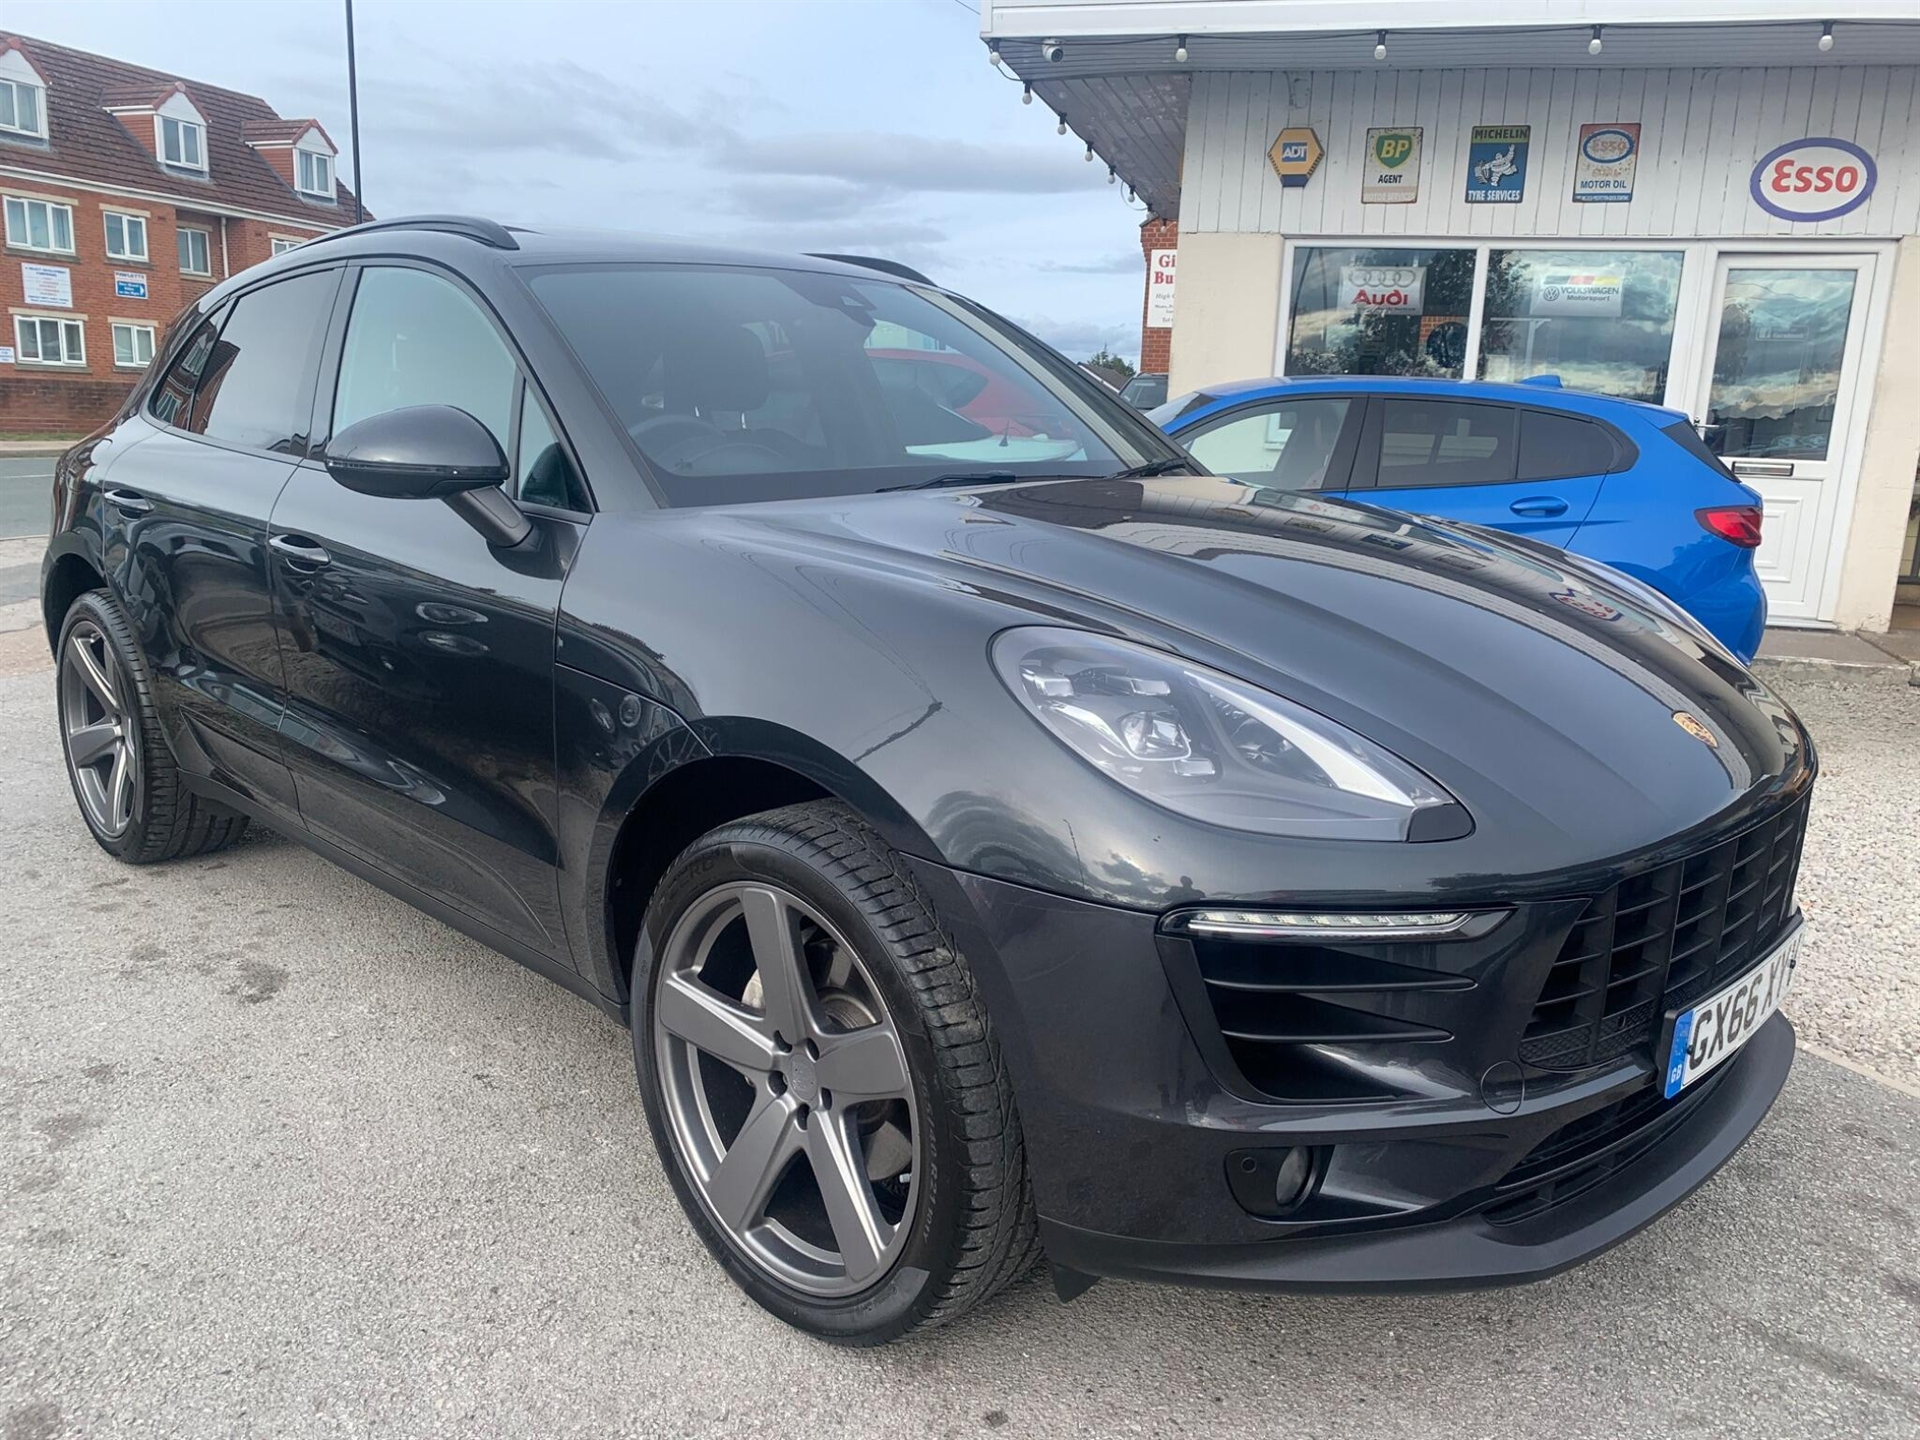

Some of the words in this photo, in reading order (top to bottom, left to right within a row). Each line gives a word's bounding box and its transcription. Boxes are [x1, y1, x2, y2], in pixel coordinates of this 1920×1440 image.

[1474, 129, 1528, 139] MICHELIN
[1282, 146, 1307, 158] ADT
[1381, 140, 1409, 157] BP
[1378, 174, 1403, 184] AGENT
[1580, 180, 1611, 189] MOTOR
[1613, 180, 1627, 189] OIL
[1468, 190, 1486, 200] TYRE
[1487, 190, 1520, 200] SERVICES
[1561, 286, 1619, 295] VOLKSWAGEN
[1351, 289, 1409, 305] Audi
[1566, 294, 1611, 302] Motorsport
[1689, 972, 1763, 1070] GX66
[1670, 1063, 1683, 1084] GB
